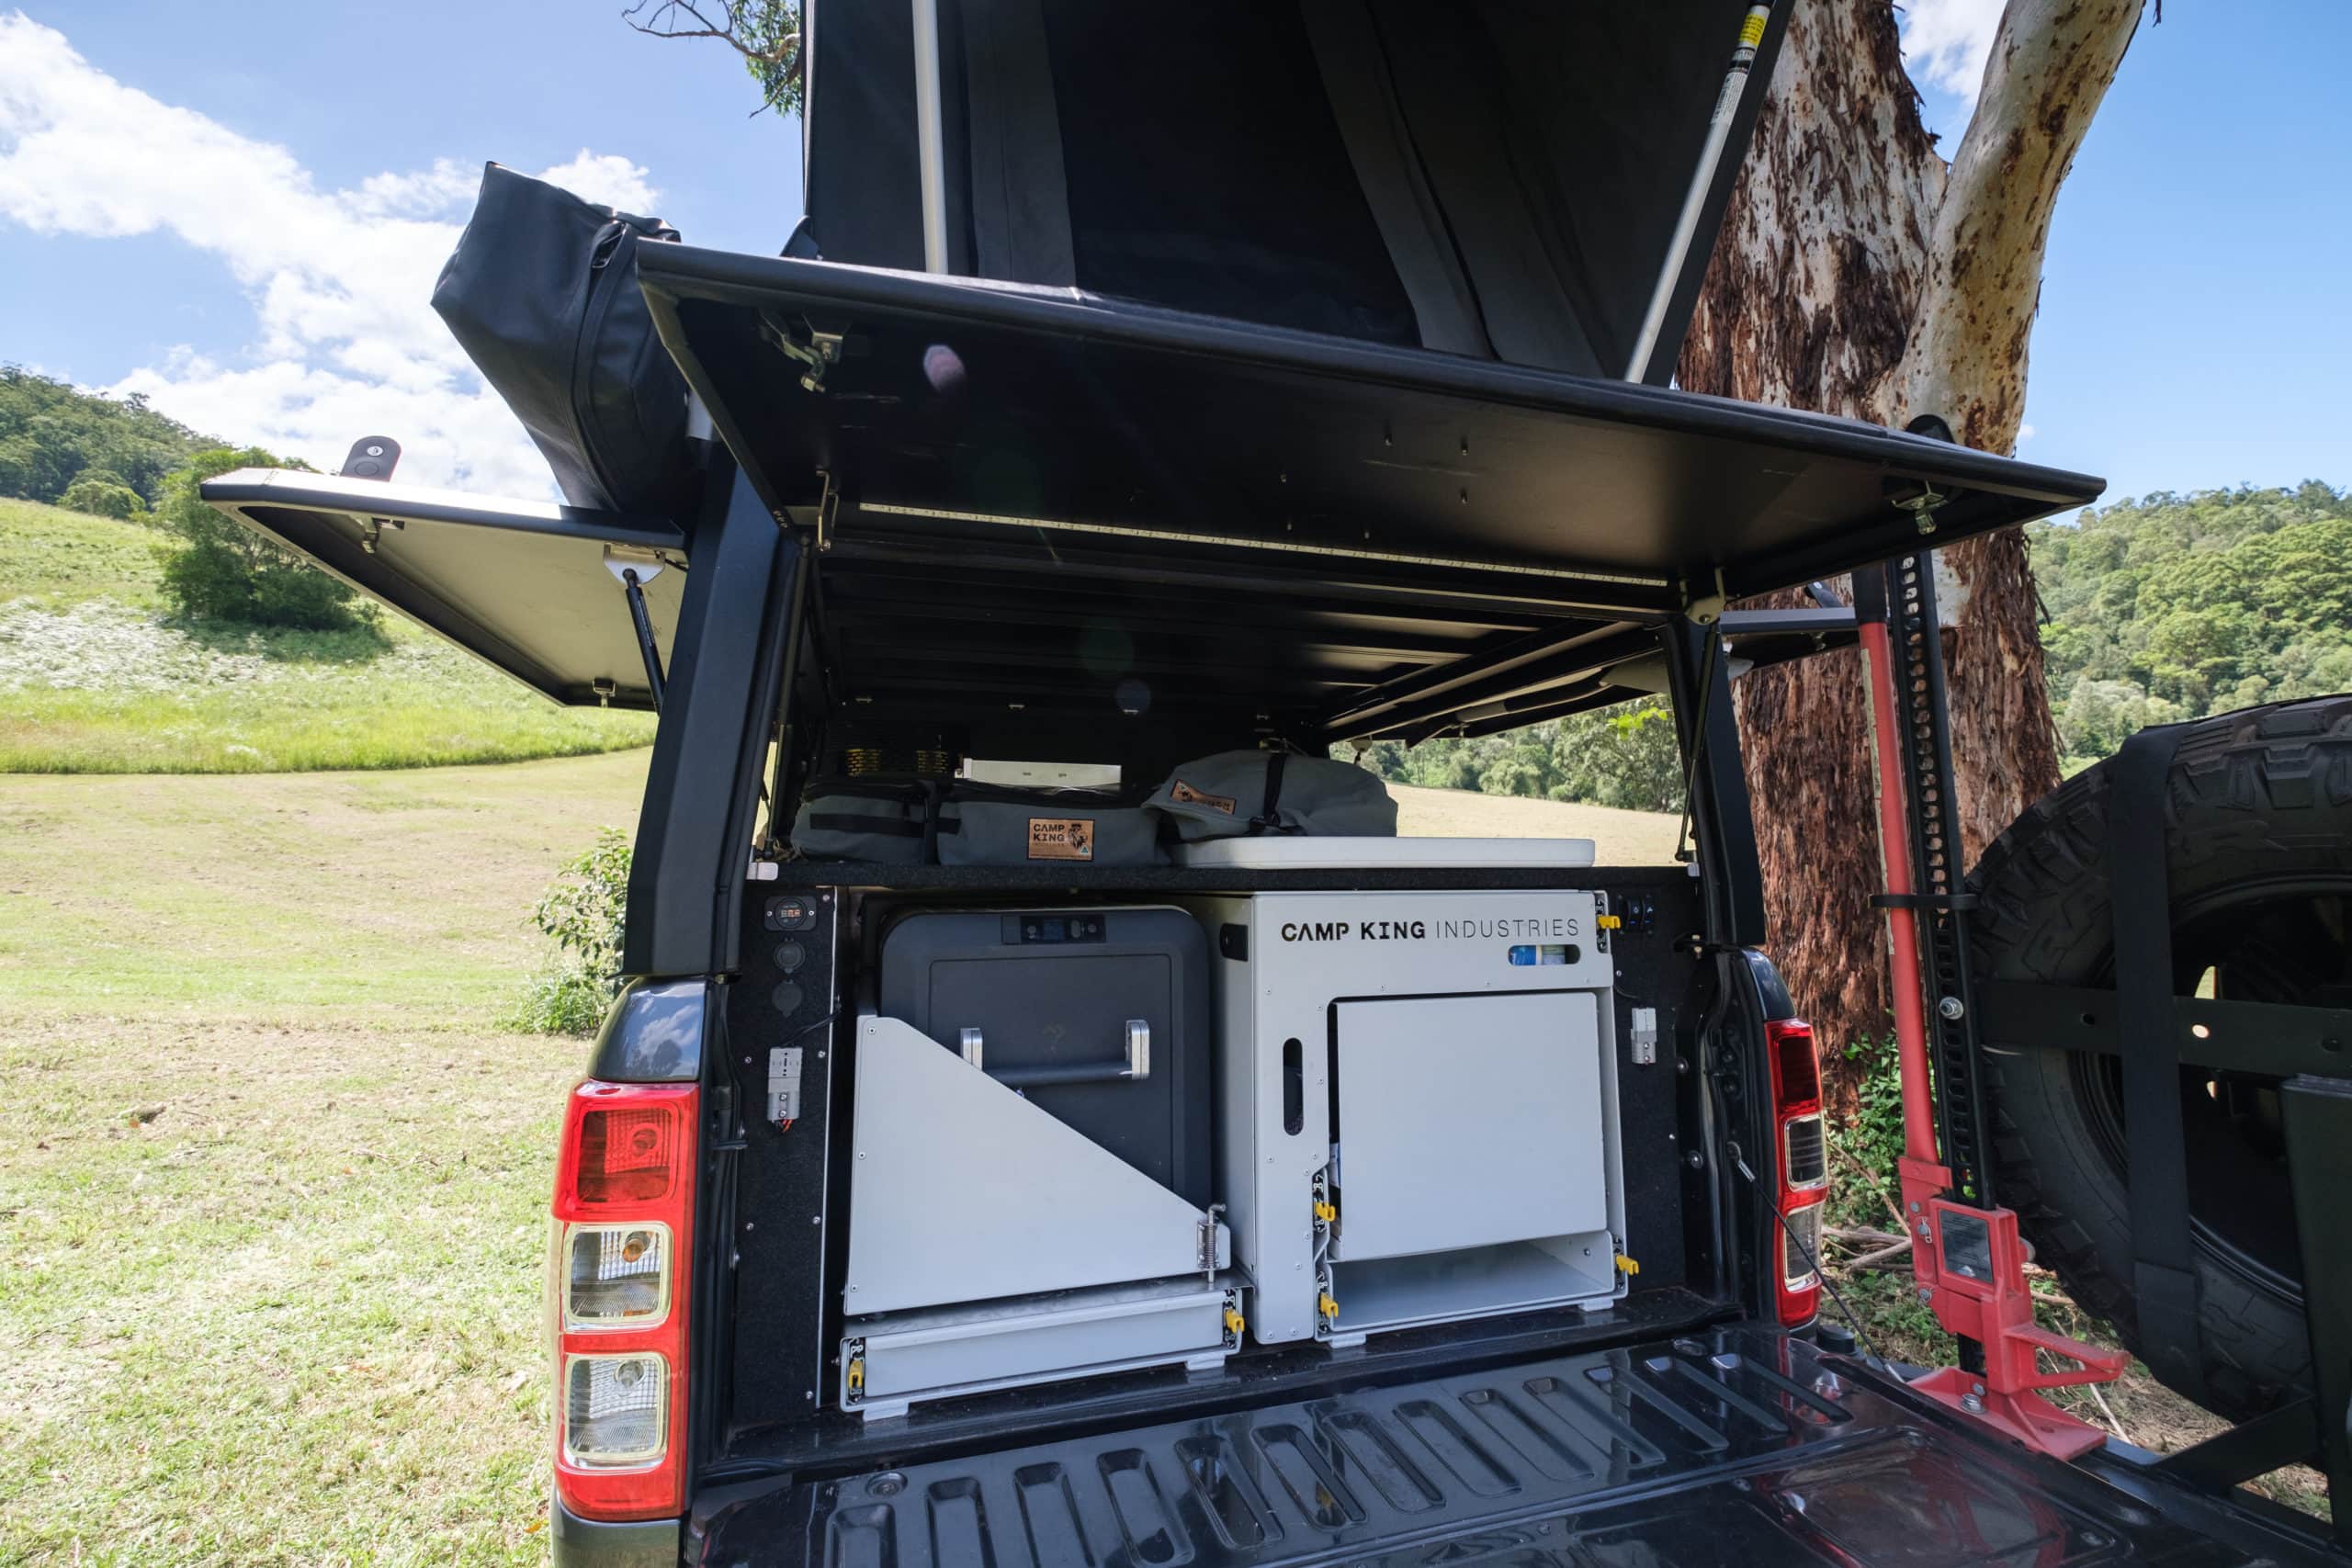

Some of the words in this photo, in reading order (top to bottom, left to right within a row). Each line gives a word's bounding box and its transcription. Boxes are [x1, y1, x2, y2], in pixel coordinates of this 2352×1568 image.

[1033, 823, 1065, 832] CAMP
[1033, 833, 1065, 842] KING
[1282, 922, 1350, 942] CAMP
[1361, 920, 1426, 940] KING
[1436, 919, 1579, 939] INDUSTRIES
